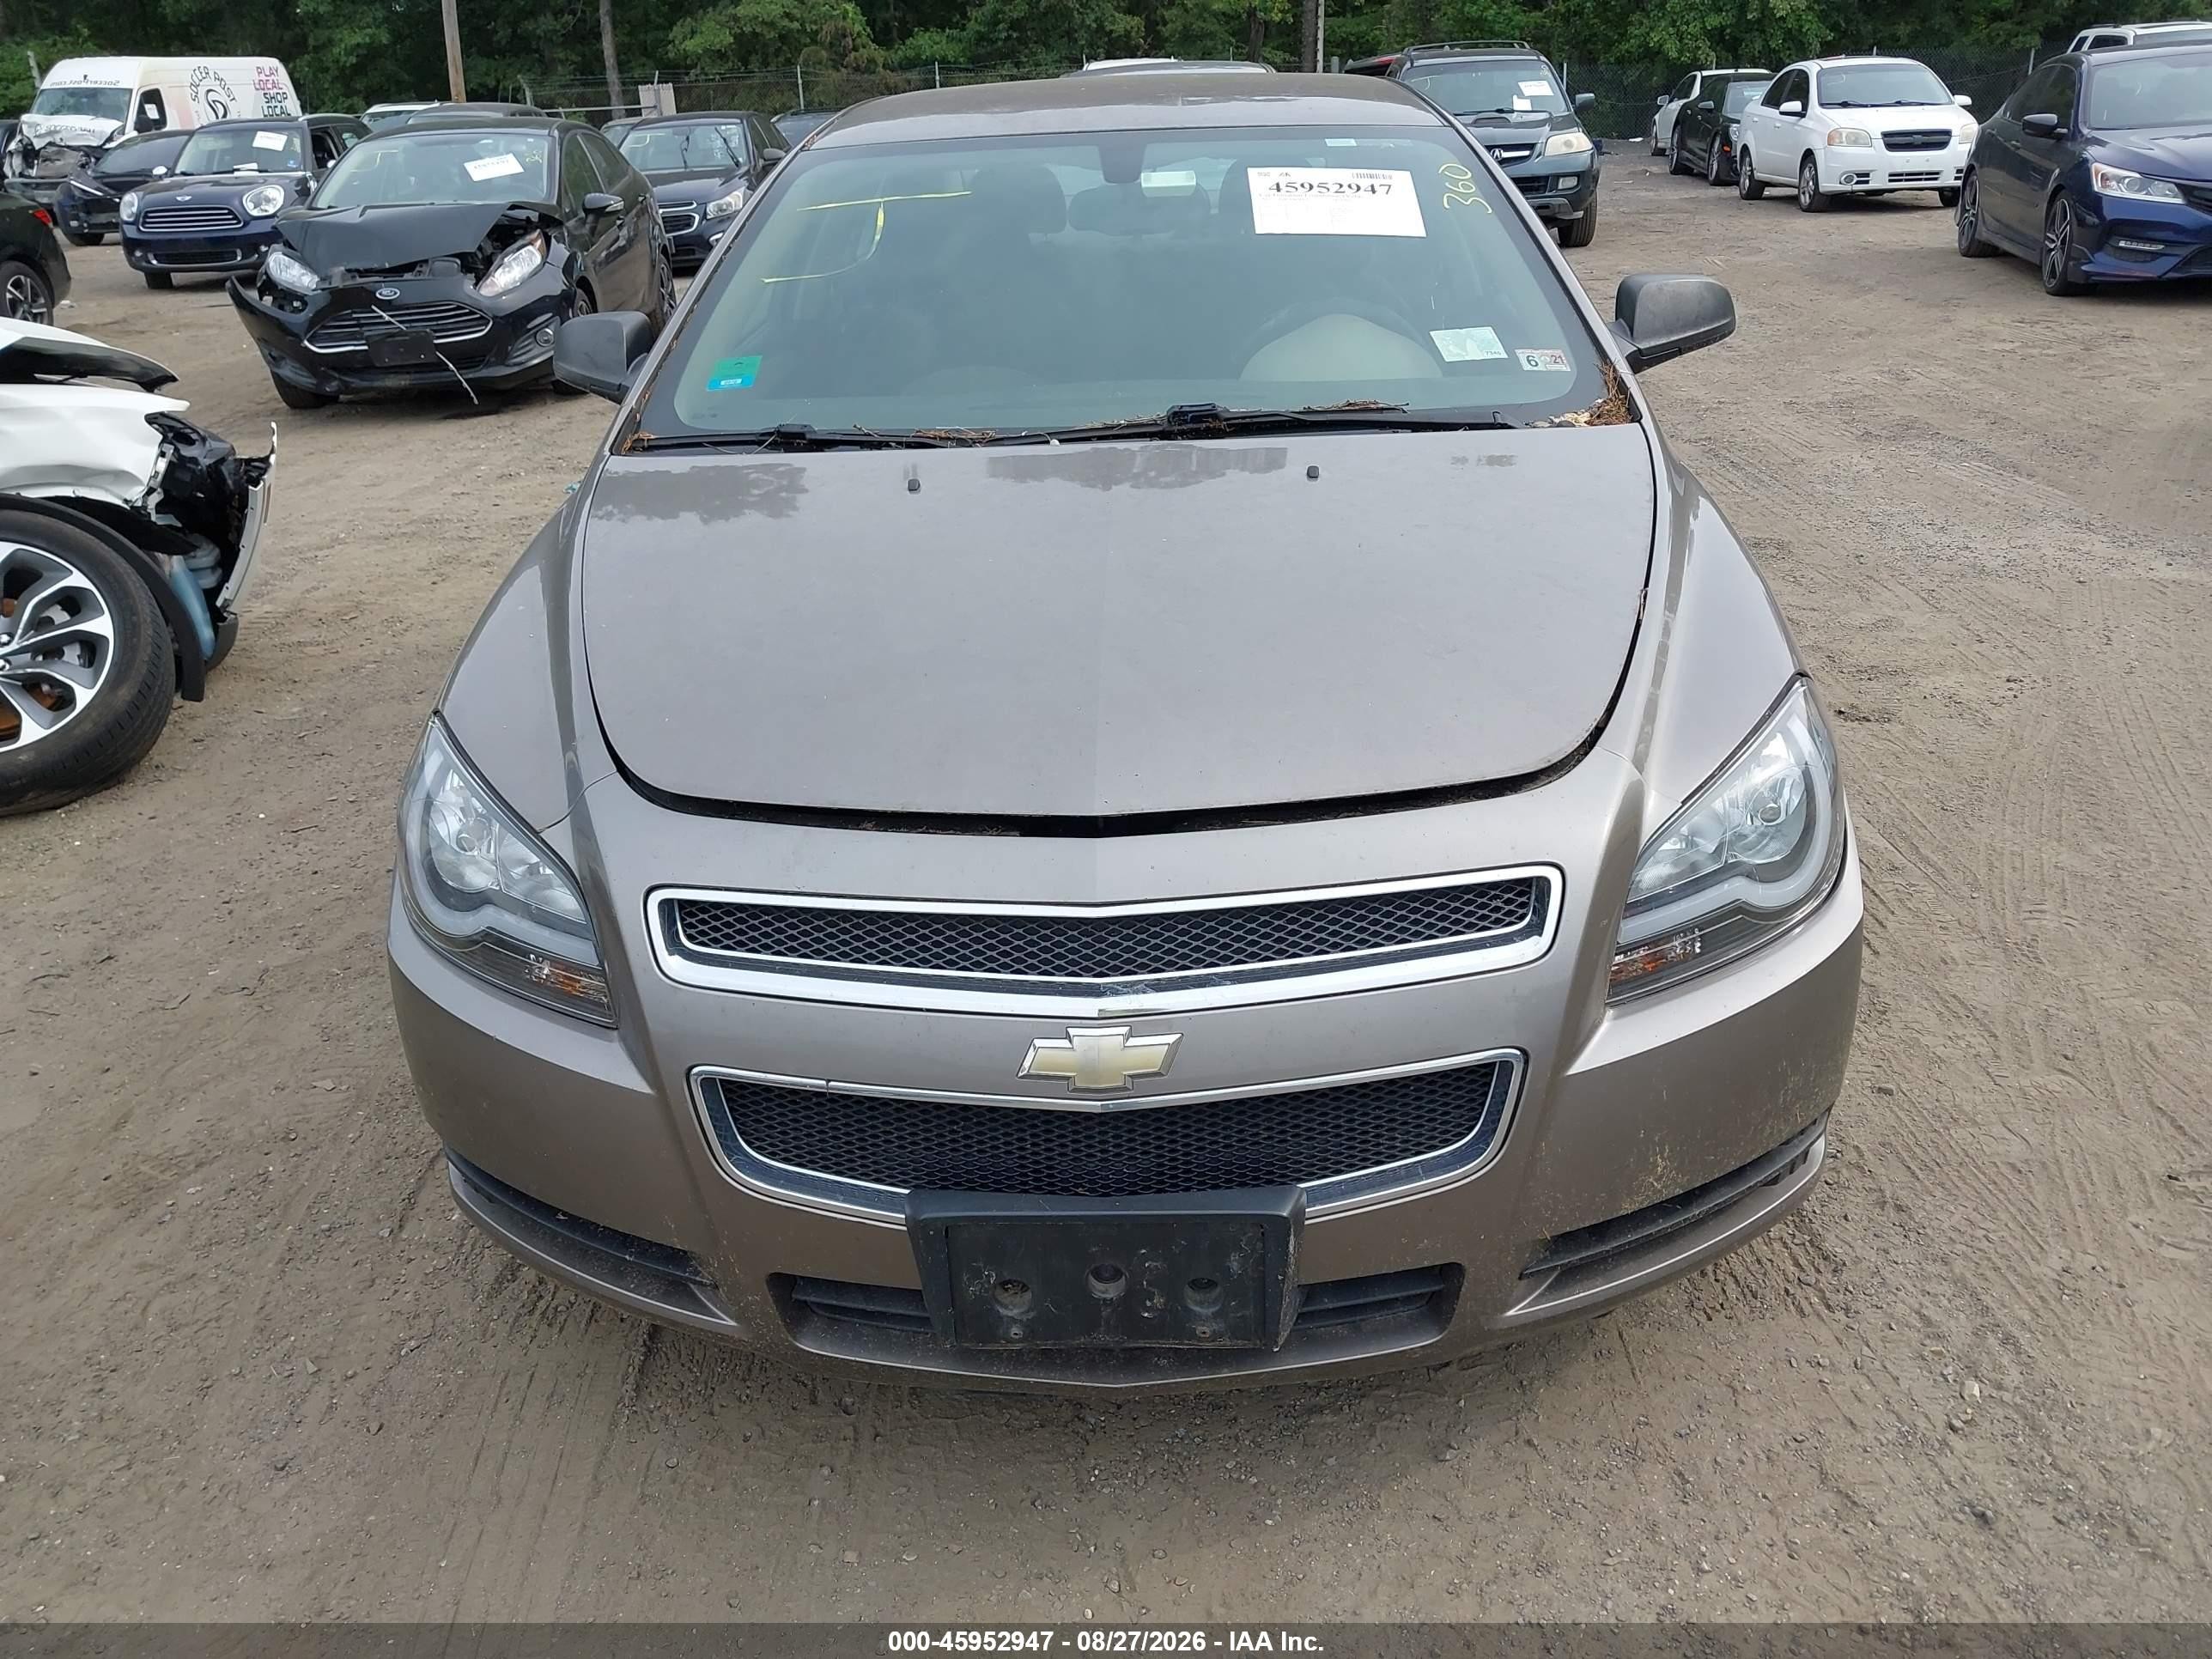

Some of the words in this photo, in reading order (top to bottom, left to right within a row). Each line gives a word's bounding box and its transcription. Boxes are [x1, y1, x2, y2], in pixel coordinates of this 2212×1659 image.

[256, 66, 280, 77] PLAY
[190, 66, 212, 103] SOCCER
[213, 71, 237, 102] POST
[252, 79, 283, 91] LOCAL
[263, 92, 288, 104] SHOP
[261, 106, 291, 118] LOCAL
[1268, 181, 1393, 195] 45952947
[1438, 163, 1492, 214] 360
[1526, 355, 1539, 368] 6
[1551, 355, 1565, 364] 21
